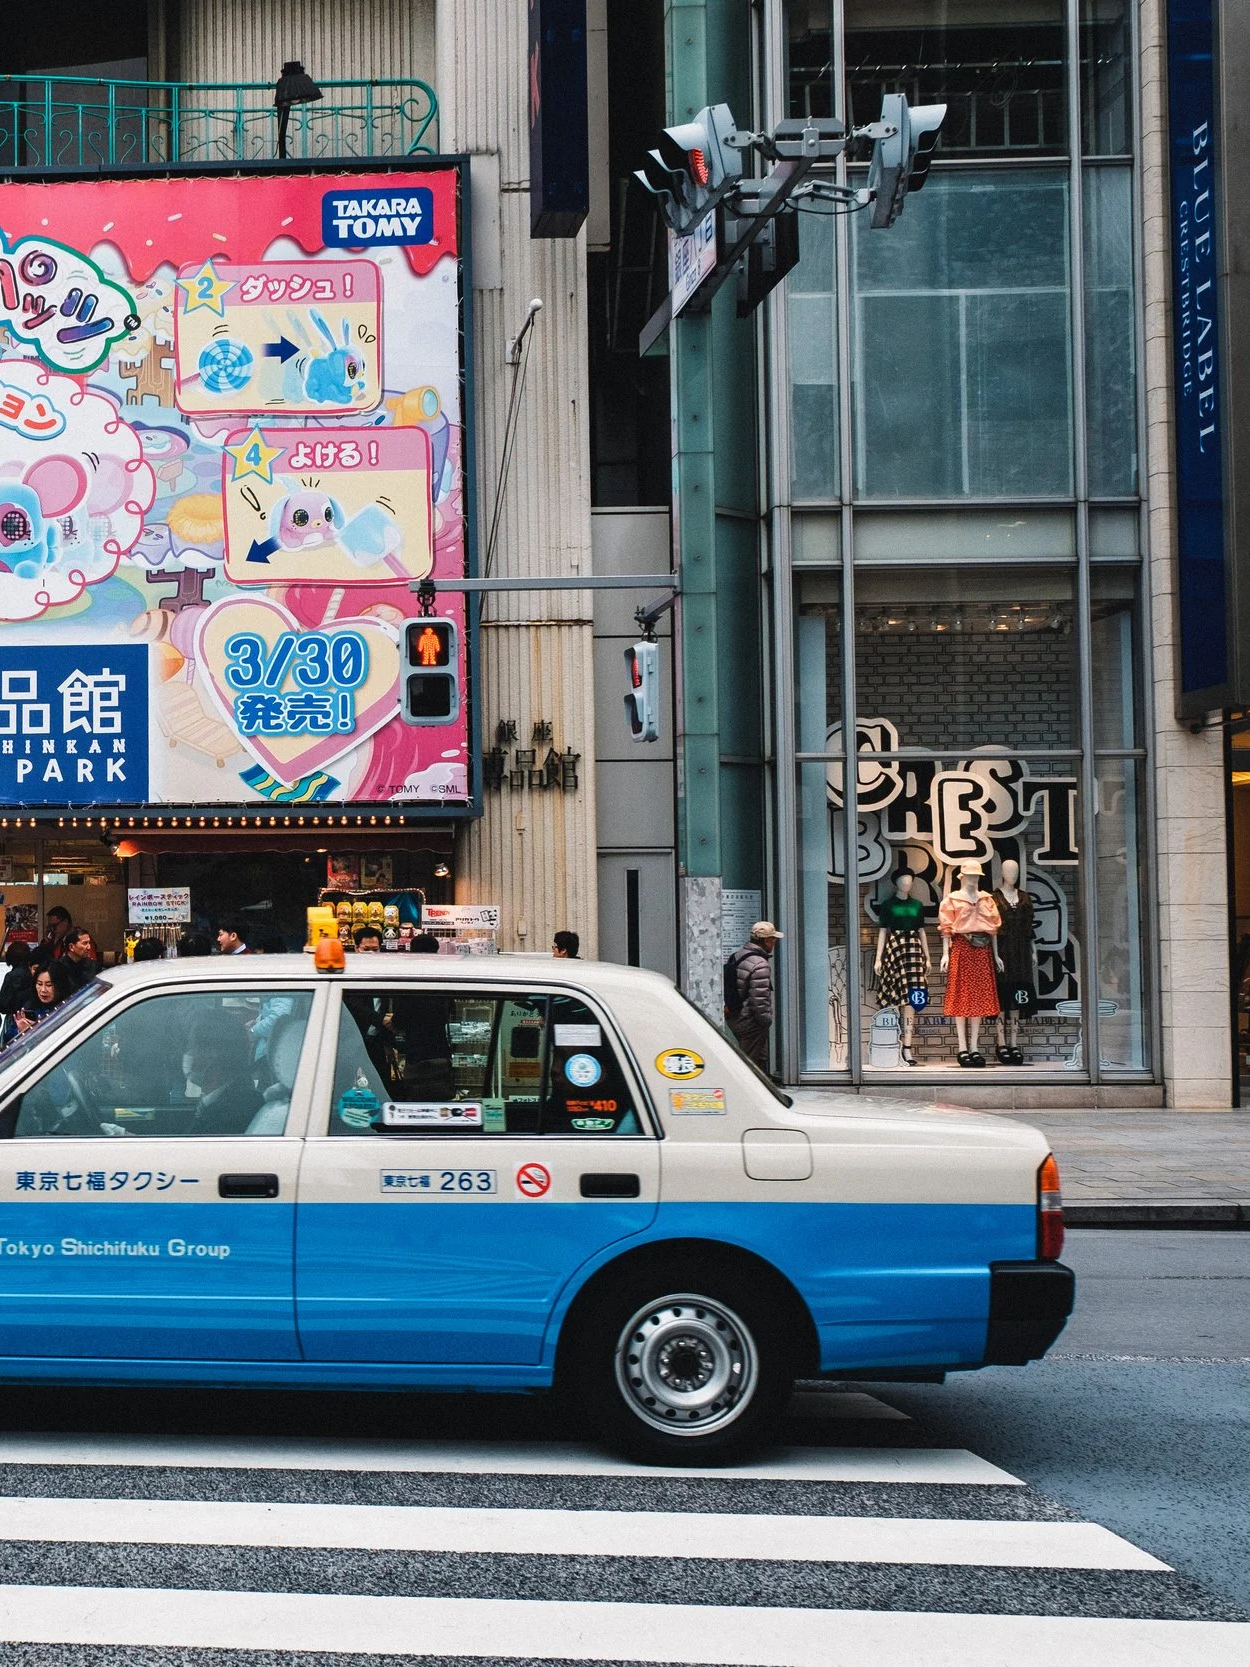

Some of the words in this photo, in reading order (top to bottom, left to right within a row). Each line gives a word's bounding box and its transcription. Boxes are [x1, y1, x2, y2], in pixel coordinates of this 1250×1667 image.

[1192, 120, 1212, 265] BLUE
[332, 198, 423, 218] TAKARA
[333, 218, 423, 239] TOMY
[197, 277, 214, 298] 2
[1179, 201, 1192, 398] CRESTBRIDGE
[1196, 280, 1216, 454] LABEL
[246, 445, 262, 467] 4
[228, 635, 366, 688] 3/30
[17, 758, 127, 783] PARK
[16, 1171, 200, 1192] 東京七福タクシー
[383, 1174, 431, 1190] 東京七福
[440, 1171, 492, 1193] 263
[61, 1238, 160, 1257] Shichifuku
[167, 1239, 231, 1259] Group
